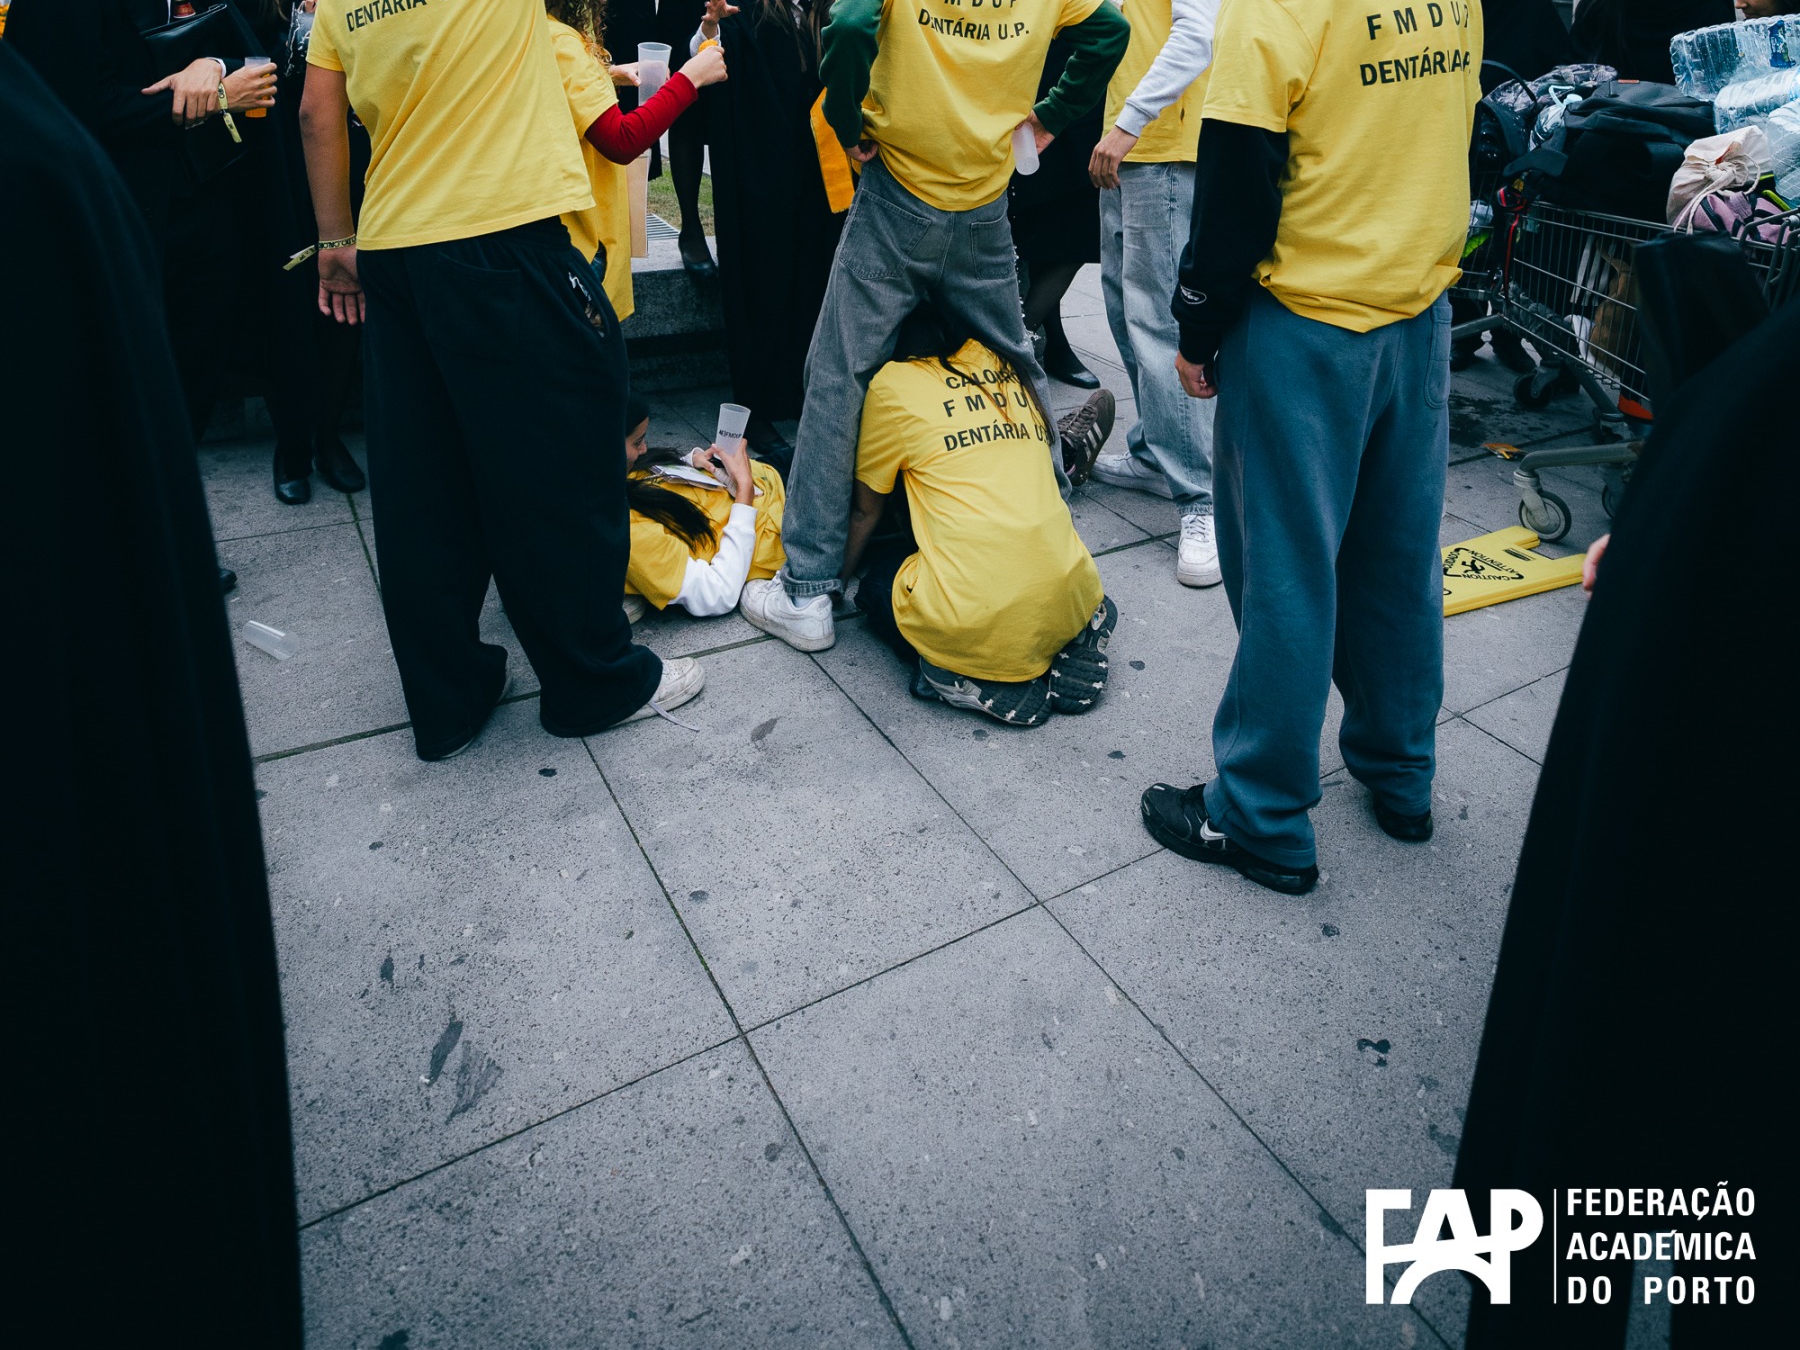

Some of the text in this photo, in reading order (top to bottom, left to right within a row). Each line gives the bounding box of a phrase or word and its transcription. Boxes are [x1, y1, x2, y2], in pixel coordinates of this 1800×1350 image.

[918, 8, 1030, 41] DNTÁRIA U.P.
[943, 419, 1031, 451] DENTÁRIA
[1468, 550, 1520, 574] ATTENTION
[1462, 573, 1511, 581] CAUTION
